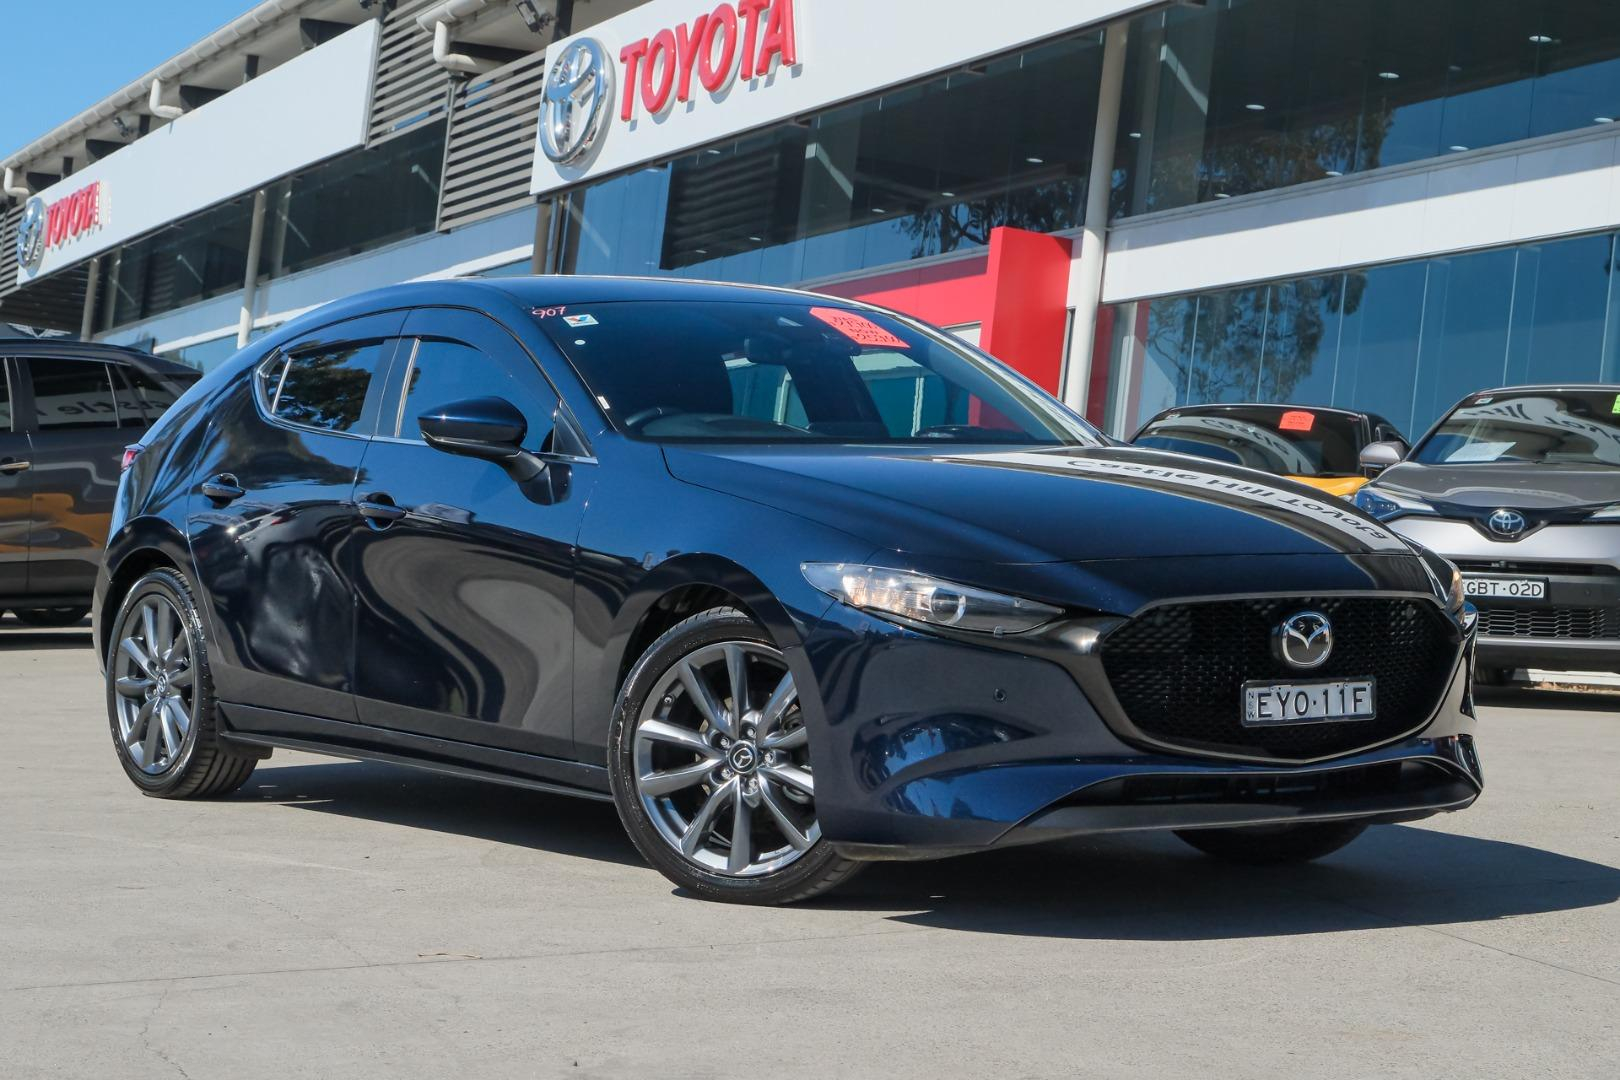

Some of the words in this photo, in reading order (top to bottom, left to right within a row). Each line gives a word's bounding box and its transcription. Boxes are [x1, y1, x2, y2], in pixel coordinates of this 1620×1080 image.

[620, 0, 797, 122] TOYOTA
[45, 180, 100, 248] TOYOTA
[532, 306, 566, 319] 907
